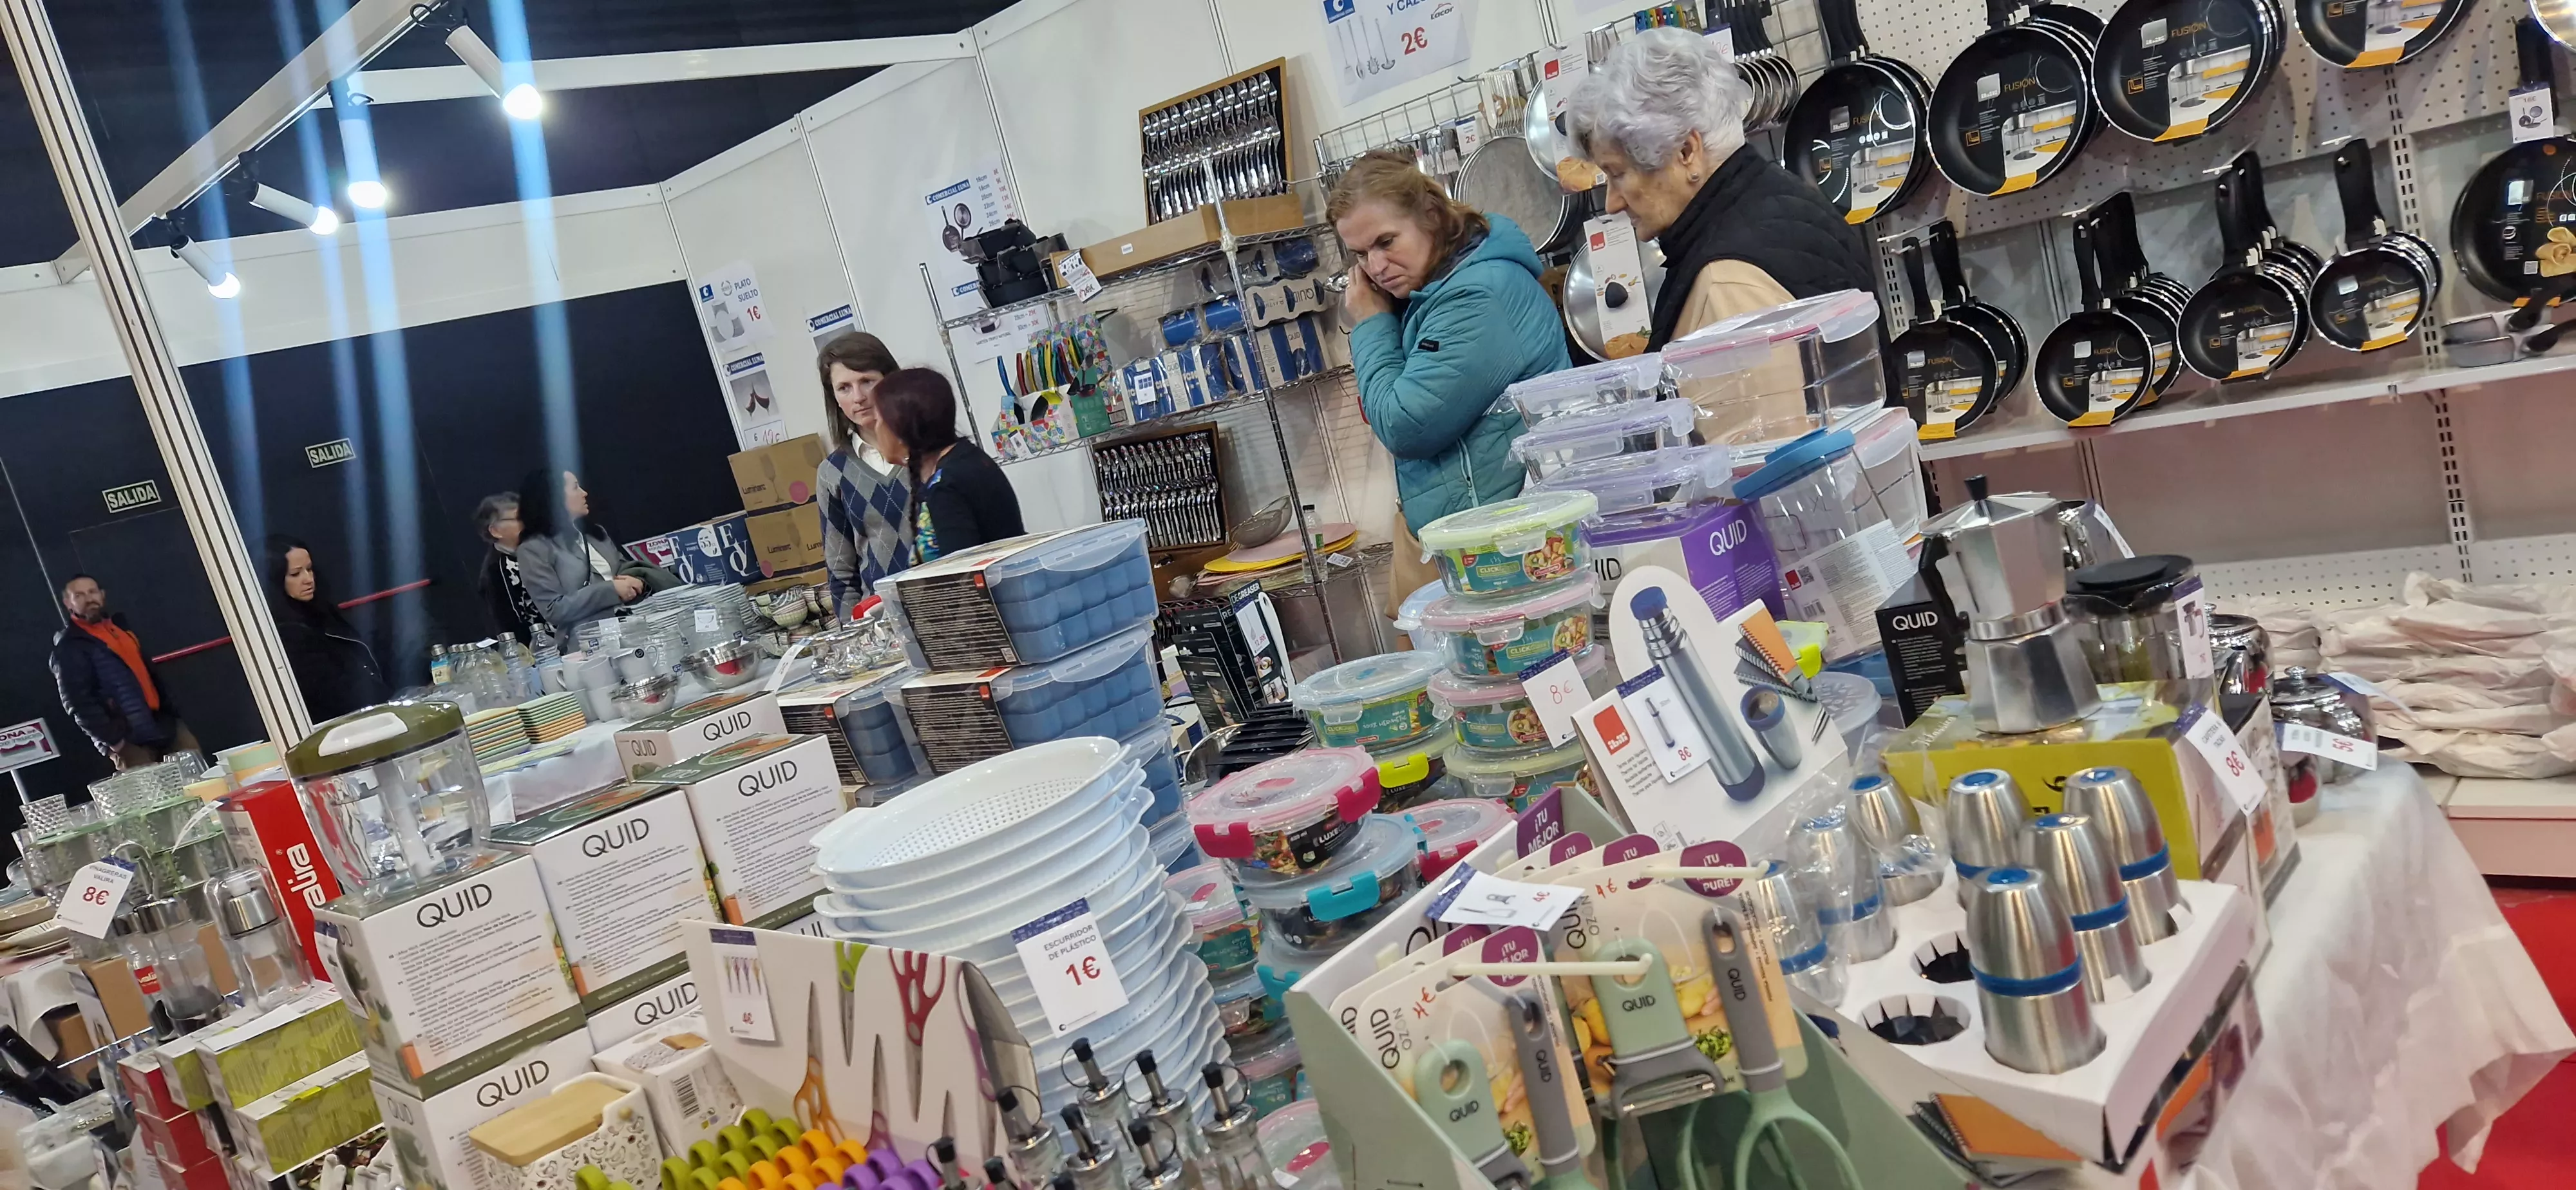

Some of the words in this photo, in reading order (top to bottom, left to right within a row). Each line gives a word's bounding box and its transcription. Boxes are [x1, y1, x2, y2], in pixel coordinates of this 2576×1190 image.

[1387, 3, 1394, 15] Y
[1397, 0, 1426, 11] CAZ
[1431, 6, 1454, 20] Lacor
[2172, 22, 2206, 37] FUSION
[1401, 26, 1428, 55] 2€
[2004, 77, 2036, 92] FUSION
[933, 184, 958, 201] COMERCIAL
[958, 181, 970, 191] LUNA
[734, 278, 752, 290] PLATO
[738, 288, 759, 303] SUELTO
[747, 305, 761, 322] 1€
[815, 311, 838, 326] COMERCIAL
[838, 307, 852, 317] LUNA
[730, 358, 751, 371] COMERCIAL
[752, 355, 764, 364] LUNA
[308, 442, 352, 464] SALIDA
[106, 484, 156, 509] SALIDA
[742, 484, 766, 495] Luminarc
[1709, 519, 1747, 556] QUID
[768, 544, 791, 554] Luminarc
[1893, 612, 1938, 630] QUID
[1549, 679, 1573, 704] 8€
[703, 712, 751, 741] QUID
[631, 739, 657, 757] QUID
[1607, 730, 1628, 750] ibili
[1678, 746, 1692, 761] 8€
[2226, 751, 2246, 777] 8€
[738, 760, 797, 797] QUID
[1535, 808, 1548, 833] ¡TU
[582, 818, 650, 858] QUID
[1528, 821, 1559, 855] MEJOR
[1565, 845, 1577, 859] ¡TU
[90, 865, 127, 880] VINAGRERAS
[93, 874, 114, 884] VALIRA
[82, 886, 109, 905] 8€
[1703, 879, 1735, 892] PURE!
[416, 883, 493, 928] QUID
[1043, 924, 1094, 952] ESCURRIDOR
[1048, 951, 1059, 961] DE
[1060, 934, 1097, 957] PLÁSTICO
[1501, 949, 1529, 963] EJOR
[1066, 956, 1101, 986] 1€
[1728, 968, 1746, 1001] QUID
[634, 982, 697, 1026] QUID
[1622, 995, 1656, 1012] QUID
[1370, 1008, 1400, 1069] QUID
[1392, 1007, 1412, 1050] OZON
[1536, 1049, 1551, 1082] QUID
[477, 1060, 549, 1108] QUID
[1450, 1100, 1479, 1122] QUID
